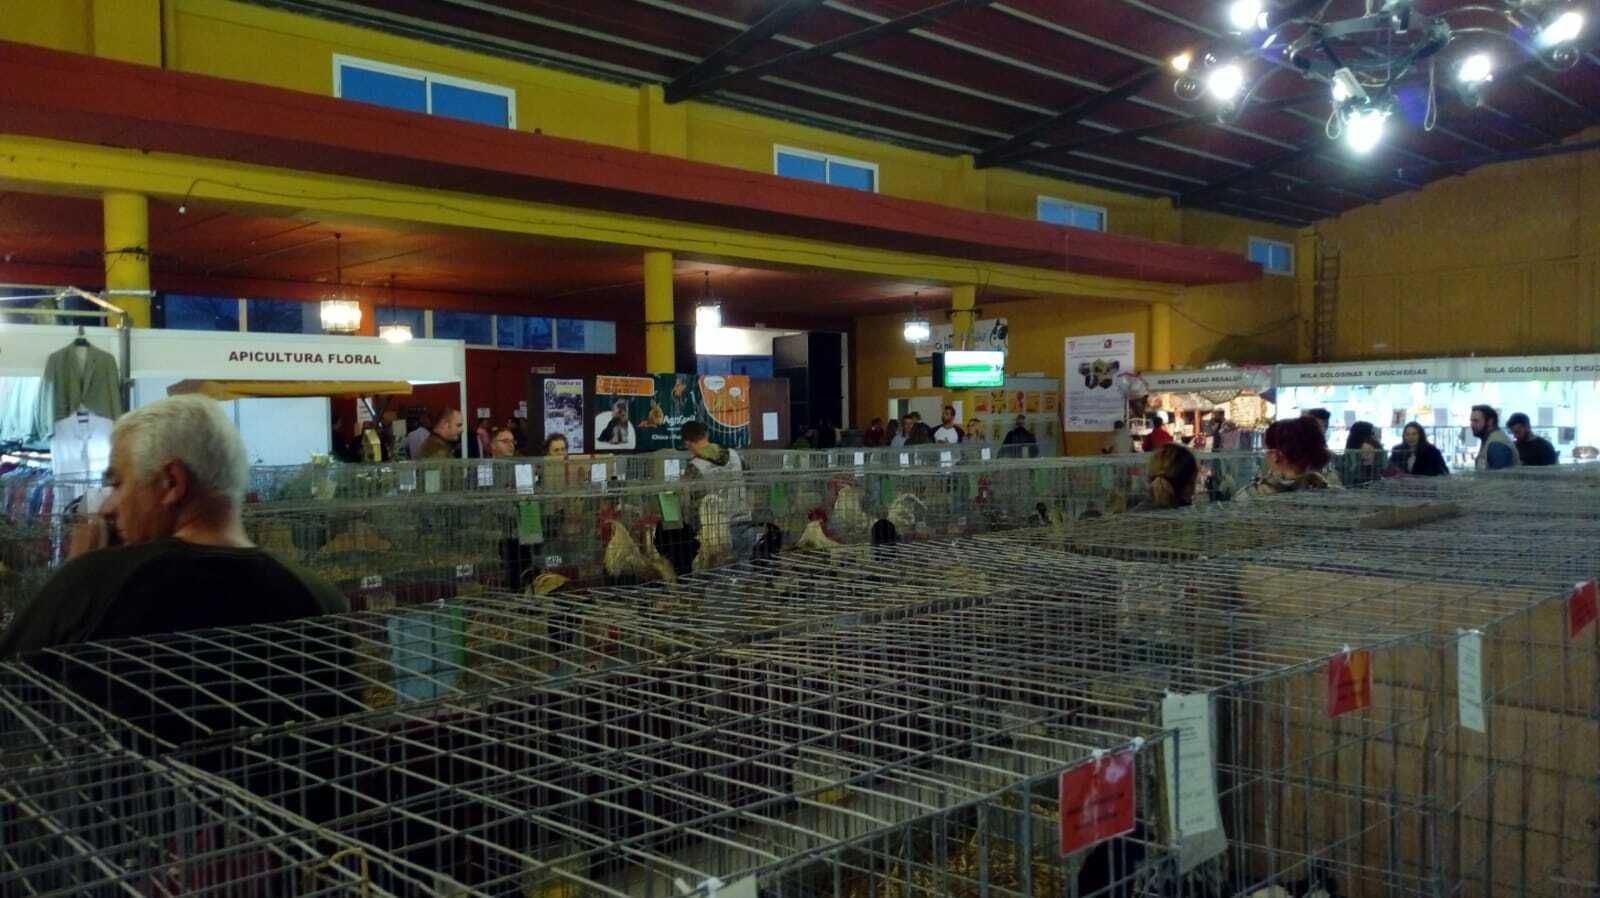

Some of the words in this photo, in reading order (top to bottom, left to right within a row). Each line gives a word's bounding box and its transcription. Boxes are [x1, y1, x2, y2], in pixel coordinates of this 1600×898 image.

[228, 351, 324, 363] APICULTURA
[328, 353, 382, 365] FLORAL
[1319, 370, 1363, 379] GOLOSINAS
[1374, 368, 1428, 377] CHUCHERIAS
[1483, 366, 1505, 374] MILA
[1507, 365, 1561, 374] GOLOSINAS
